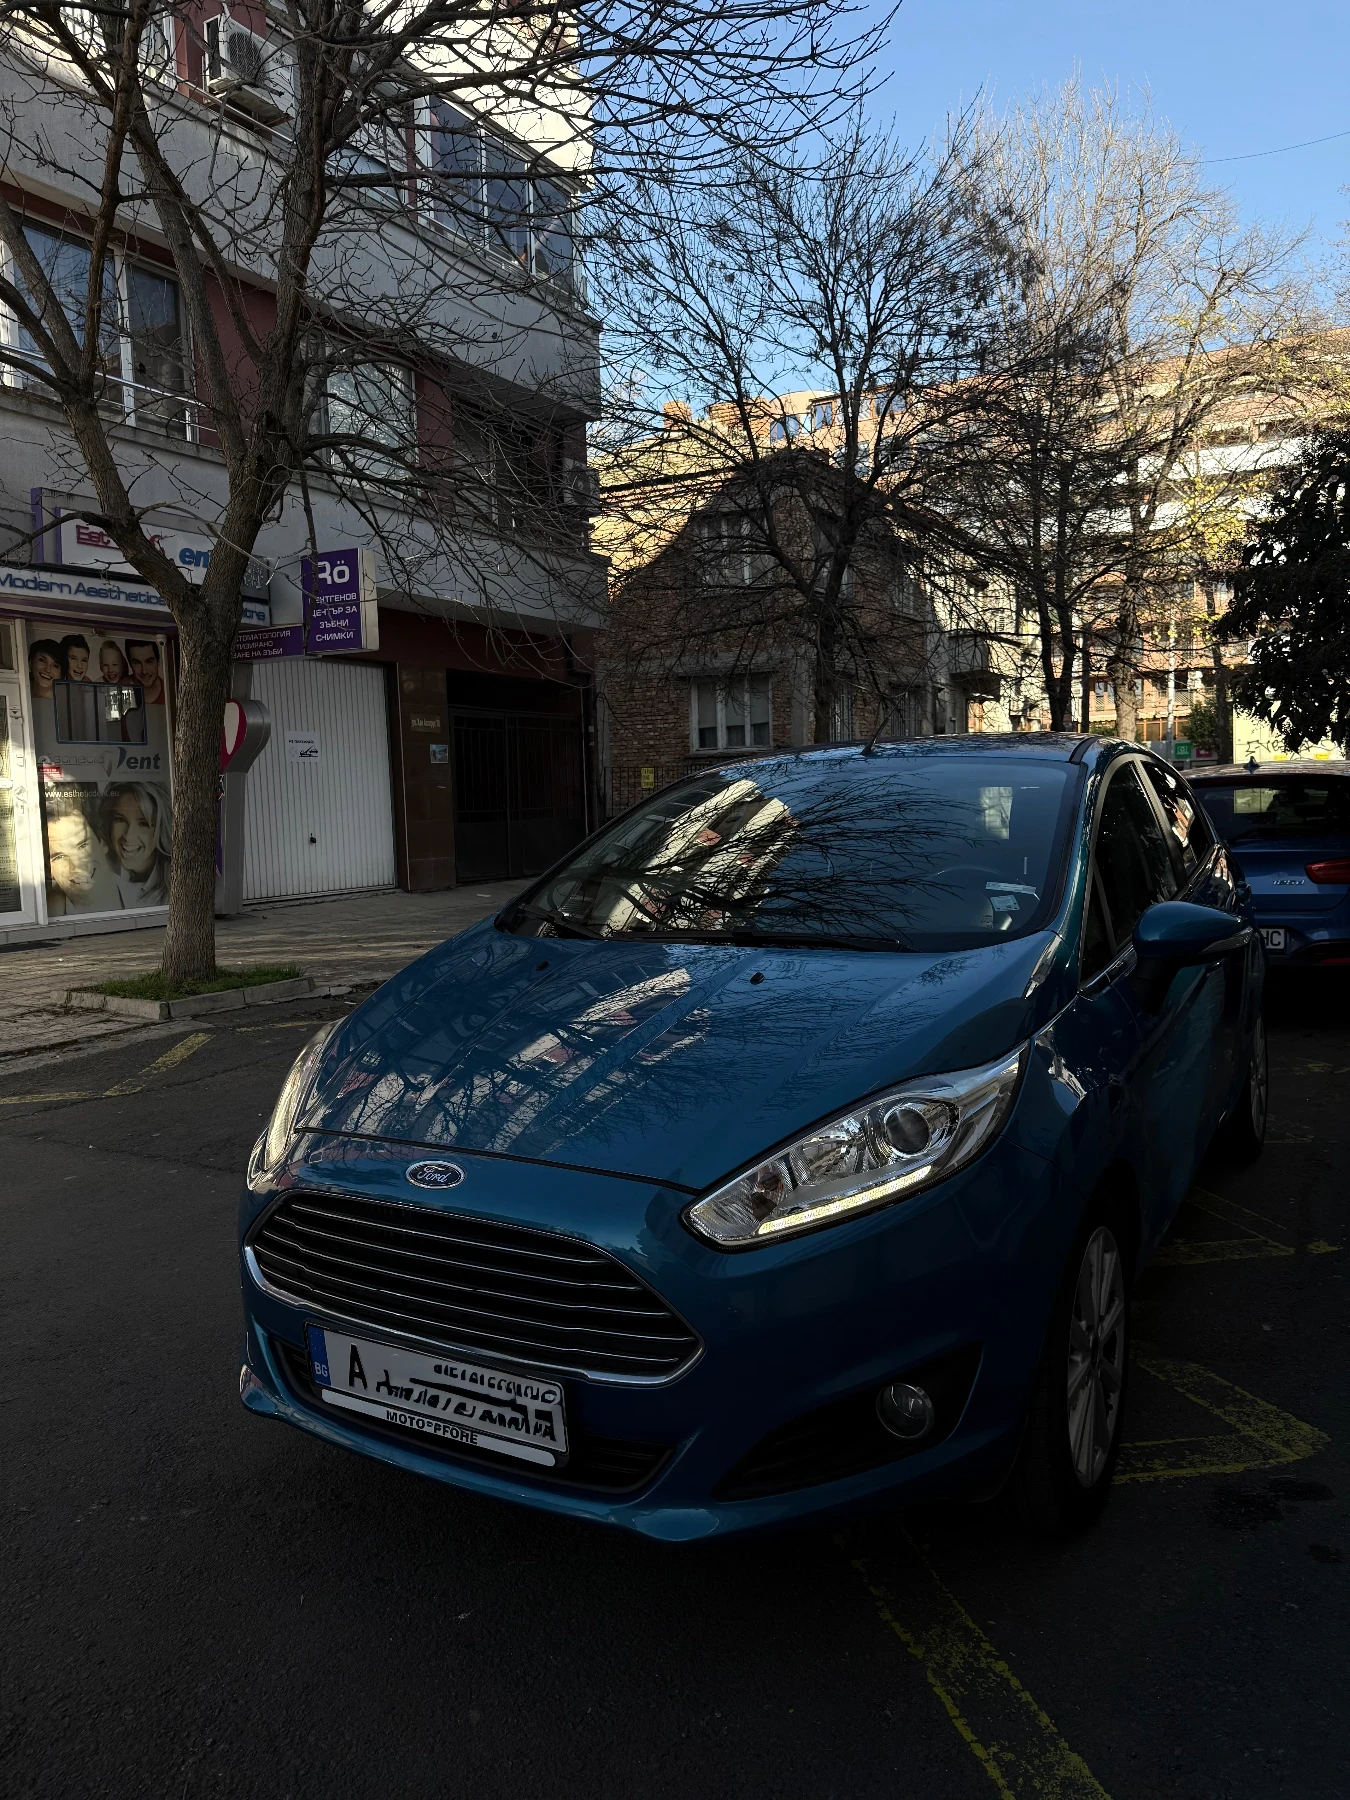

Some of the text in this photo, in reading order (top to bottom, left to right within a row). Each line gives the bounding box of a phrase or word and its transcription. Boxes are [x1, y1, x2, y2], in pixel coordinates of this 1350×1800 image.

[0, 573, 72, 595] Modern
[308, 592, 357, 605] ЕНТГЕНОВ
[345, 605, 358, 614] ЗА
[319, 619, 349, 629] ЗЪБНИ
[236, 630, 291, 642] ТОМАТОЛОГИЯ
[315, 631, 354, 642] СНИМКИ
[314, 1361, 329, 1378] BG
